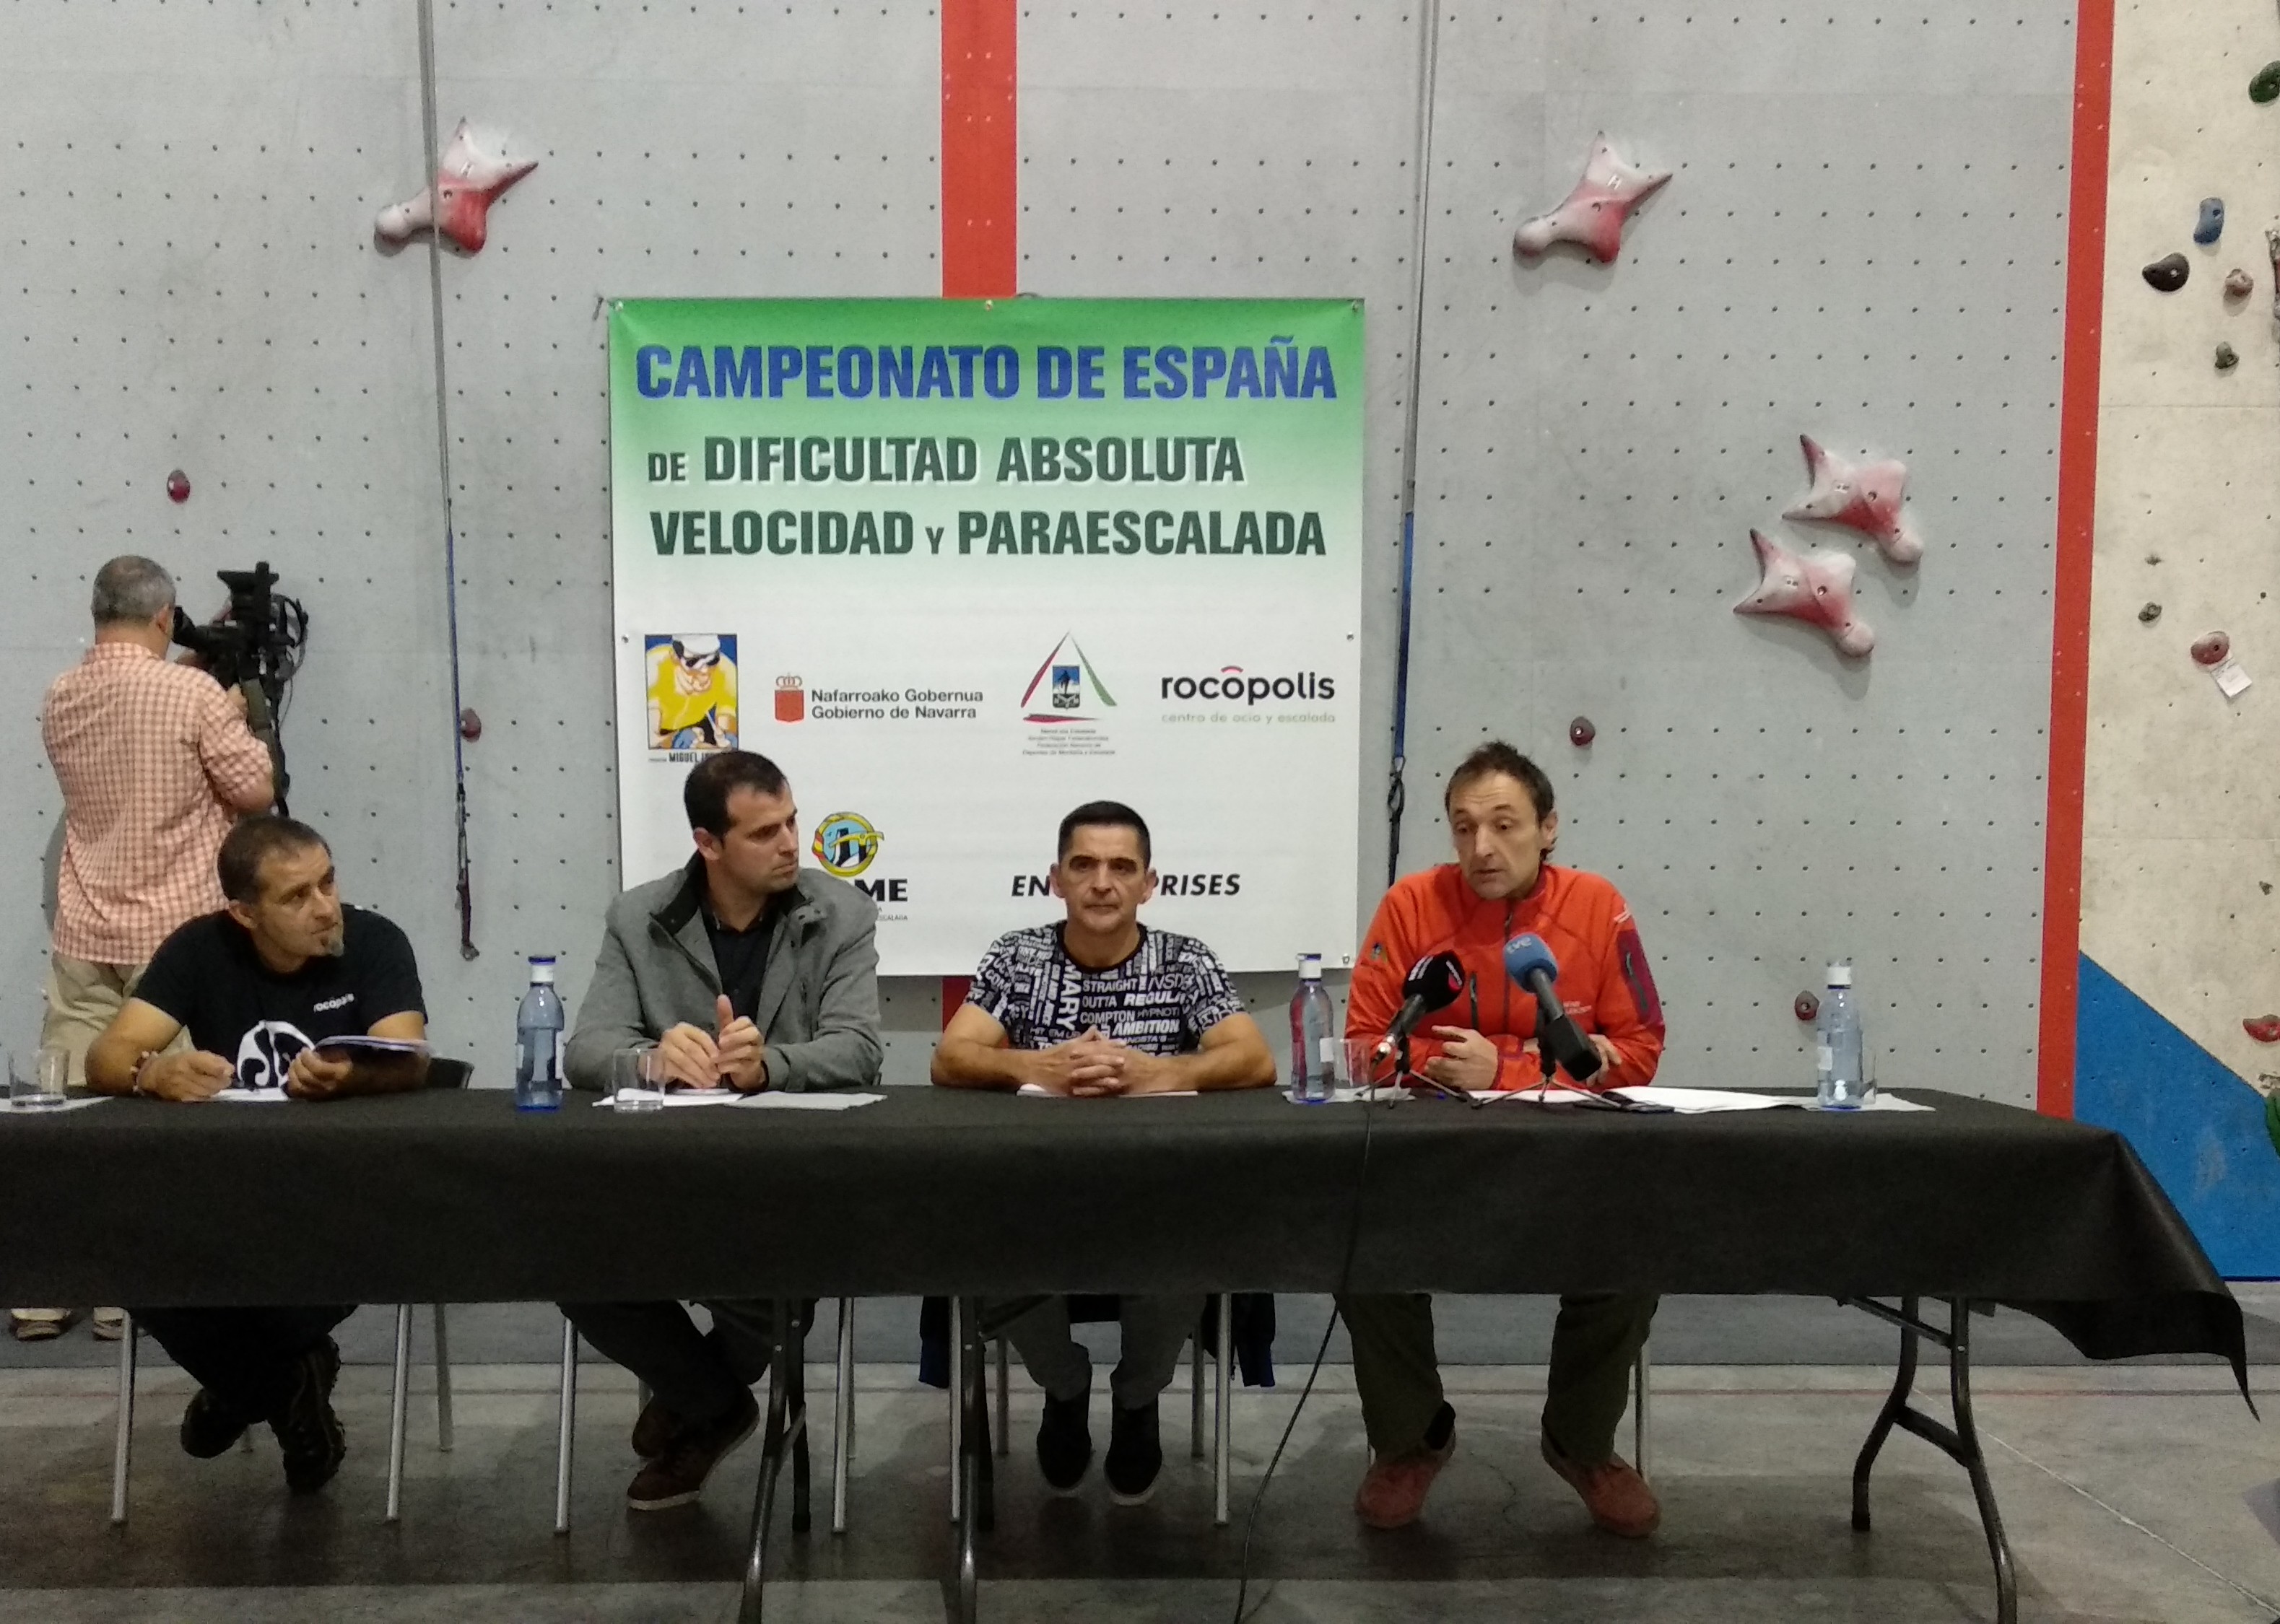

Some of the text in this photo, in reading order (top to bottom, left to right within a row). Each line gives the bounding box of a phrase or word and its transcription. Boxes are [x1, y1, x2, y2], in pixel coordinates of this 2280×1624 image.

[636, 335, 1337, 399] CAMPEONATO DE ESPAÑA
[648, 437, 1244, 481] DE DIFICULTAD ABSOLUTA
[651, 511, 913, 555] VELOCIDAD
[959, 510, 1326, 555] PARAESCALADA
[812, 689, 983, 702] Nafarroako Gobernua
[812, 705, 976, 719] Gobierno de Navarra
[1162, 712, 1205, 722] centro
[1210, 711, 1227, 722] de
[1232, 711, 1261, 722] ocio
[1278, 711, 1335, 722] escalada
[1083, 978, 1139, 993] STRAIGHT
[1082, 995, 1117, 1008] OUTTA
[1080, 1010, 1134, 1024] COMPTON
[1113, 1018, 1180, 1036] AMBITION
